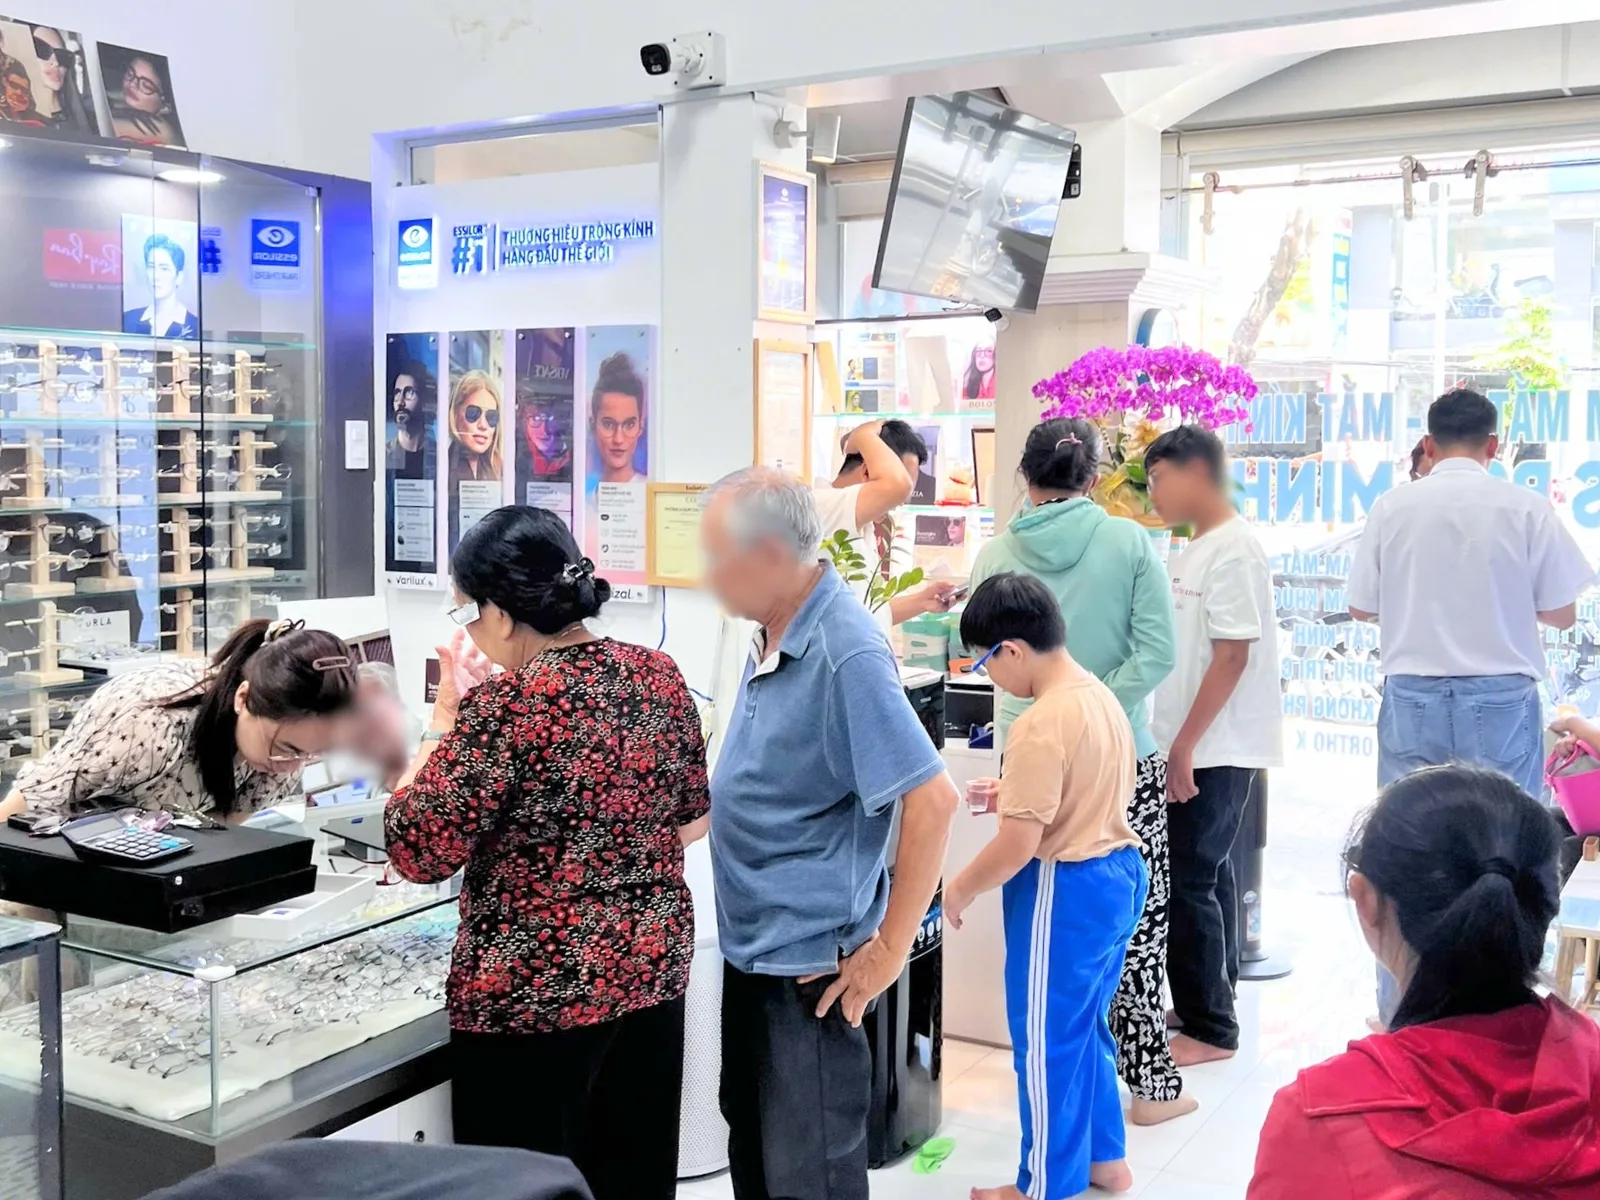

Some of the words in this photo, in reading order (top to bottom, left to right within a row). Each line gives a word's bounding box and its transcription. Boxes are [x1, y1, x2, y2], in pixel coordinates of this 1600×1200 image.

[453, 225, 484, 236] ESSILOR
[622, 217, 654, 237] KÍNH
[452, 238, 484, 274] #1
[502, 247, 534, 265] HÀNG
[584, 241, 611, 261] GIỚI
[396, 576, 426, 585] Varilux
